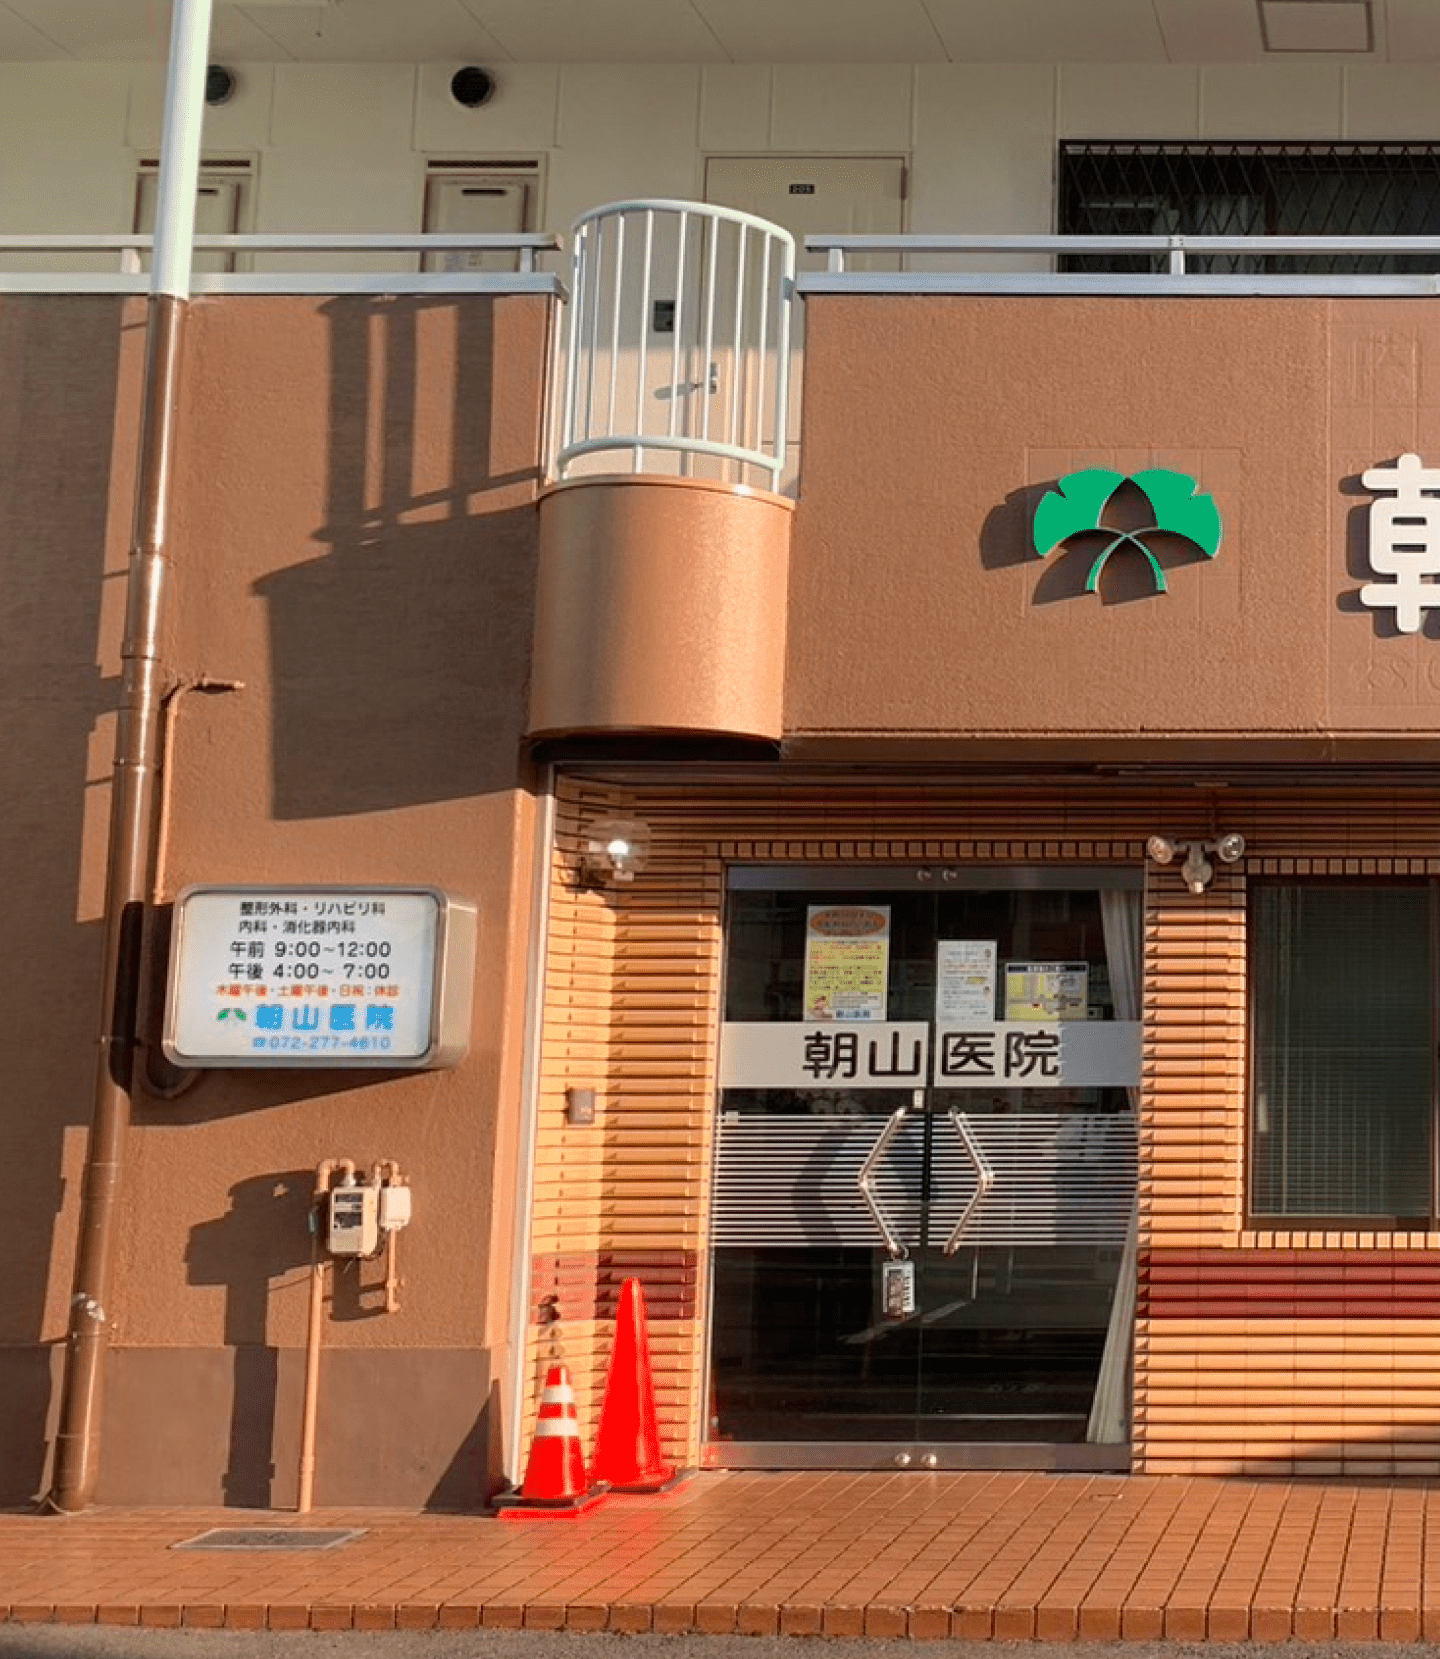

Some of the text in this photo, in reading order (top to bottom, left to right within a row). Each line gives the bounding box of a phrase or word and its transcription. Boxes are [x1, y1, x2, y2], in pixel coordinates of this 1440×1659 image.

[230, 941, 265, 958] 午前
[229, 962, 264, 980] 午後
[803, 1031, 1061, 1079] 朝山医院
